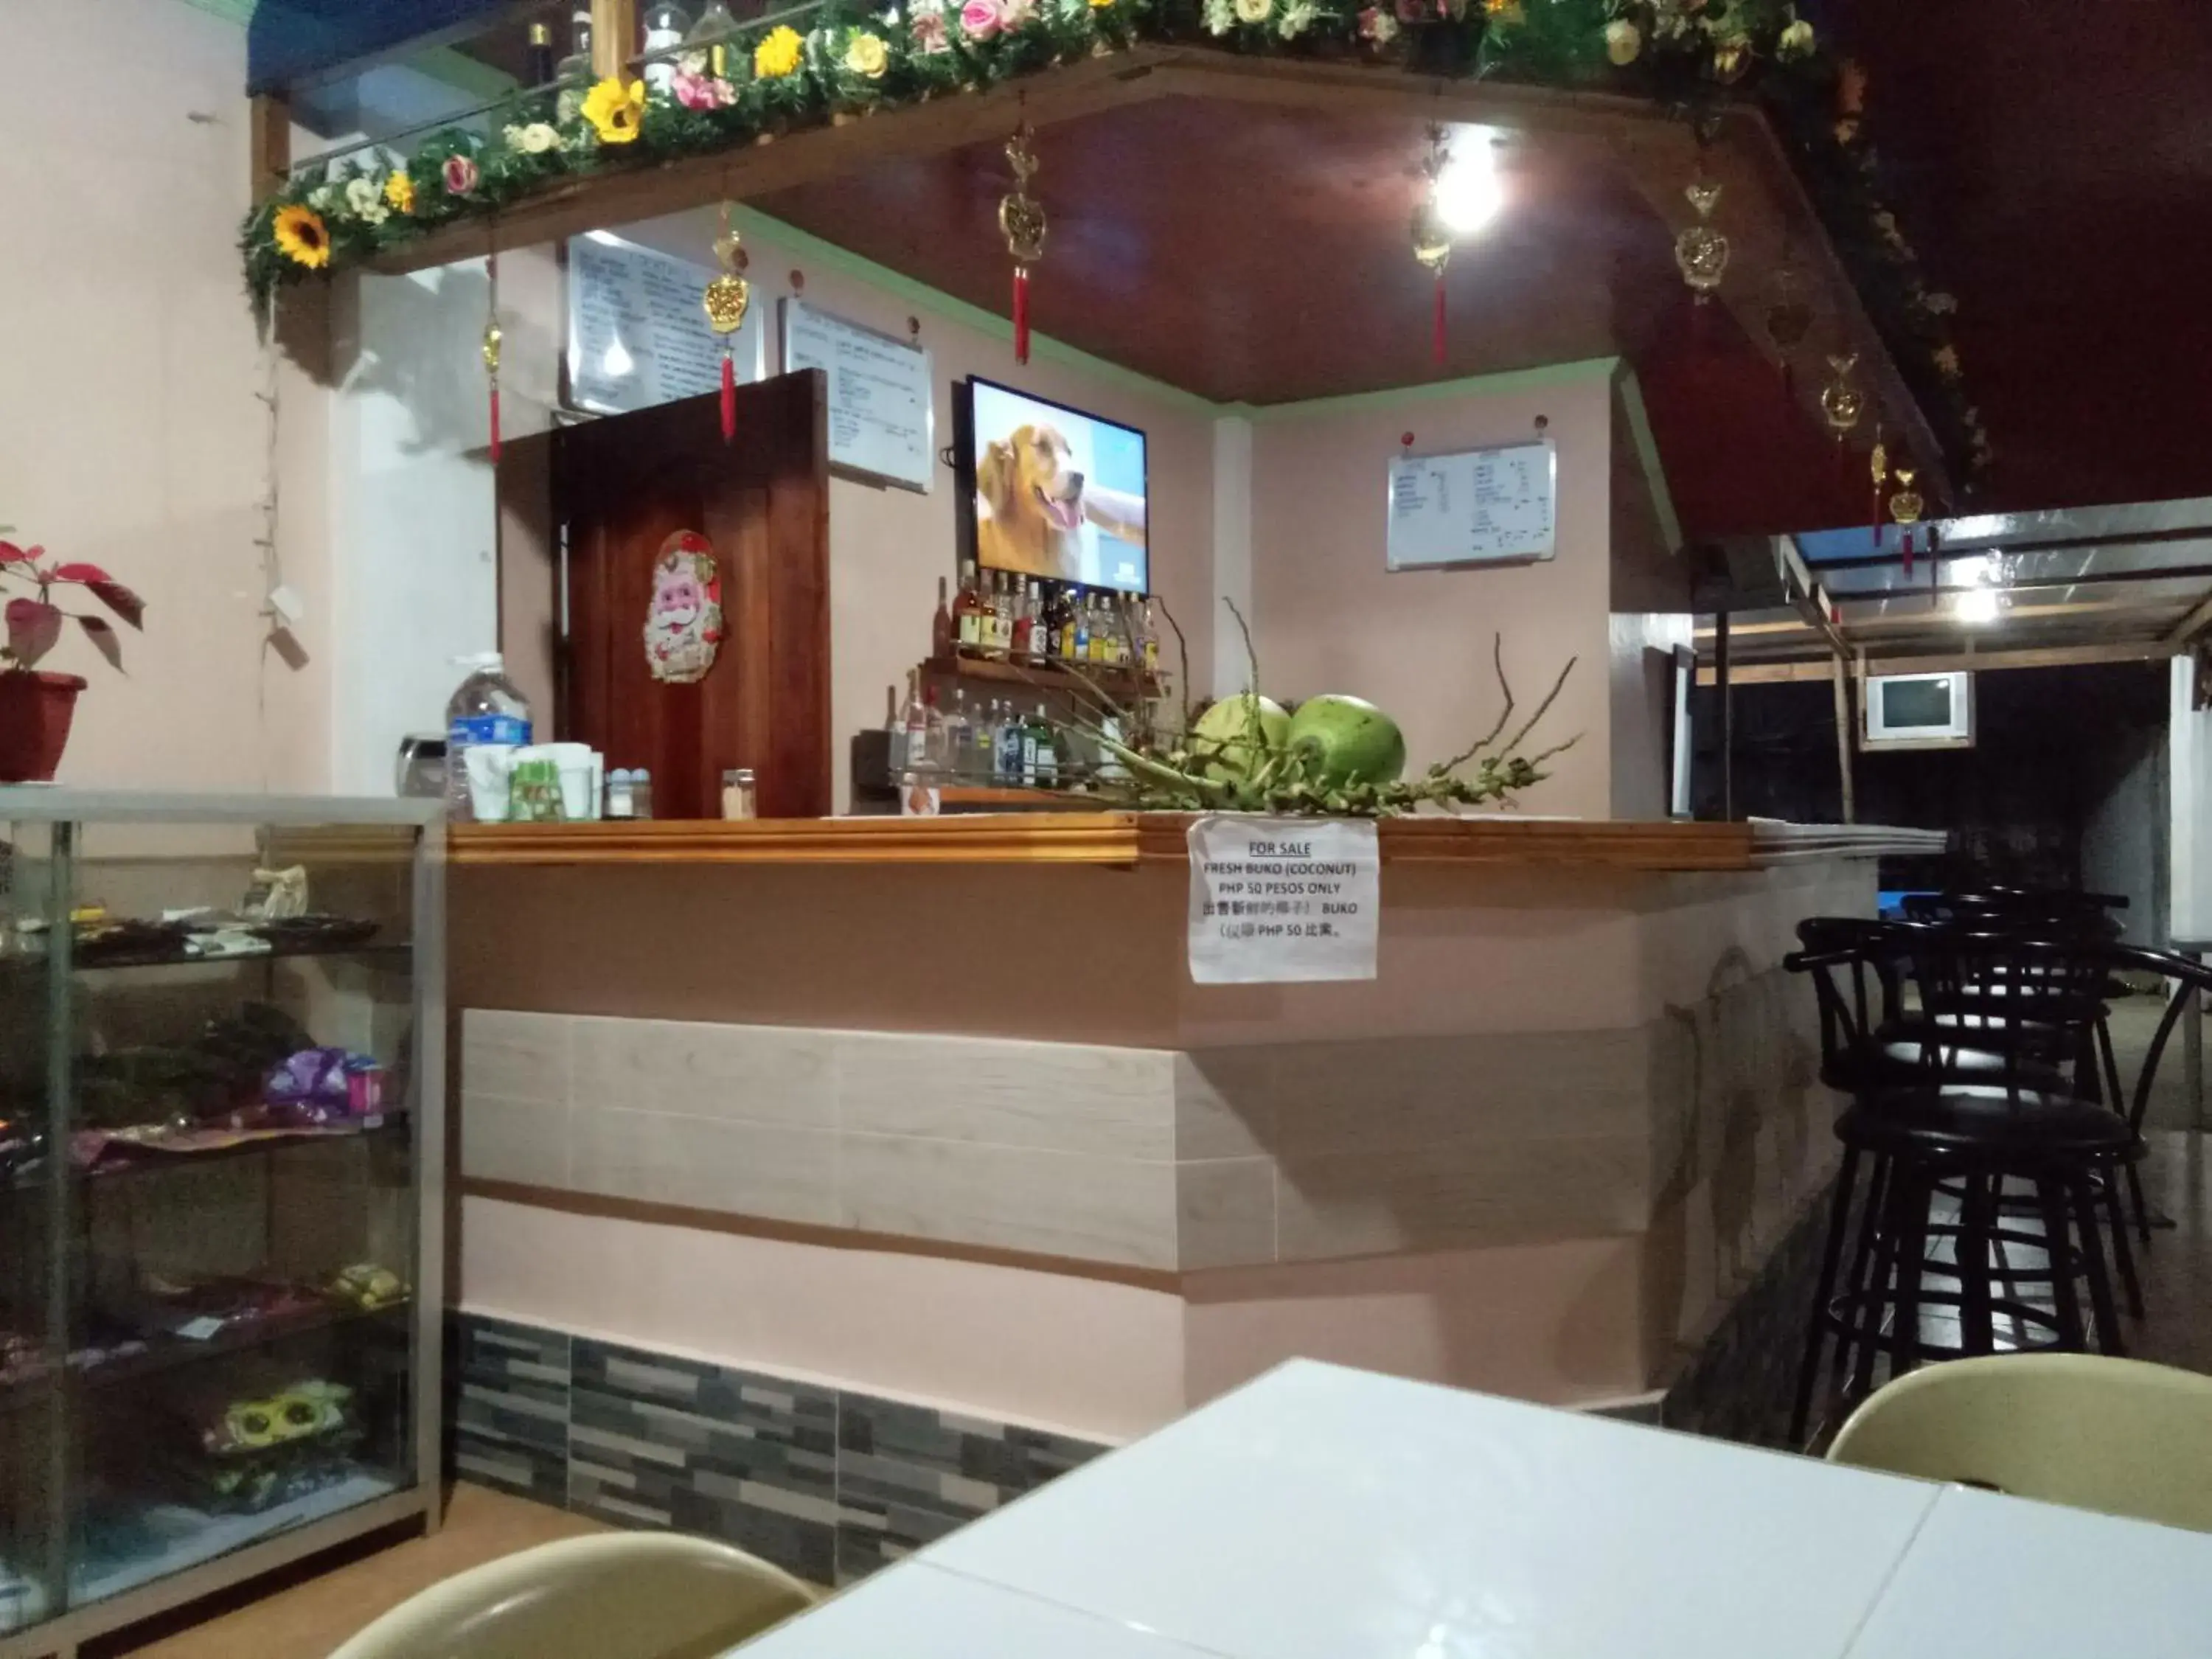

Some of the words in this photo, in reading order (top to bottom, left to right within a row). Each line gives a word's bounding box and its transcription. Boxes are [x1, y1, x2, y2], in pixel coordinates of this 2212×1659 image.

[1249, 841, 1276, 855] FOR
[1279, 842, 1311, 855] SALE
[1203, 863, 1242, 875] FRESH
[1245, 863, 1283, 875] BUKO
[1285, 863, 1357, 877] (COCONUT)
[1219, 883, 1244, 894] PHP
[1247, 882, 1262, 894] 50
[1265, 882, 1304, 894] PESOS
[1307, 882, 1341, 894] ONLY
[1321, 902, 1358, 914] BUKO
[1258, 924, 1283, 936] PHP
[1287, 924, 1301, 936] 50
